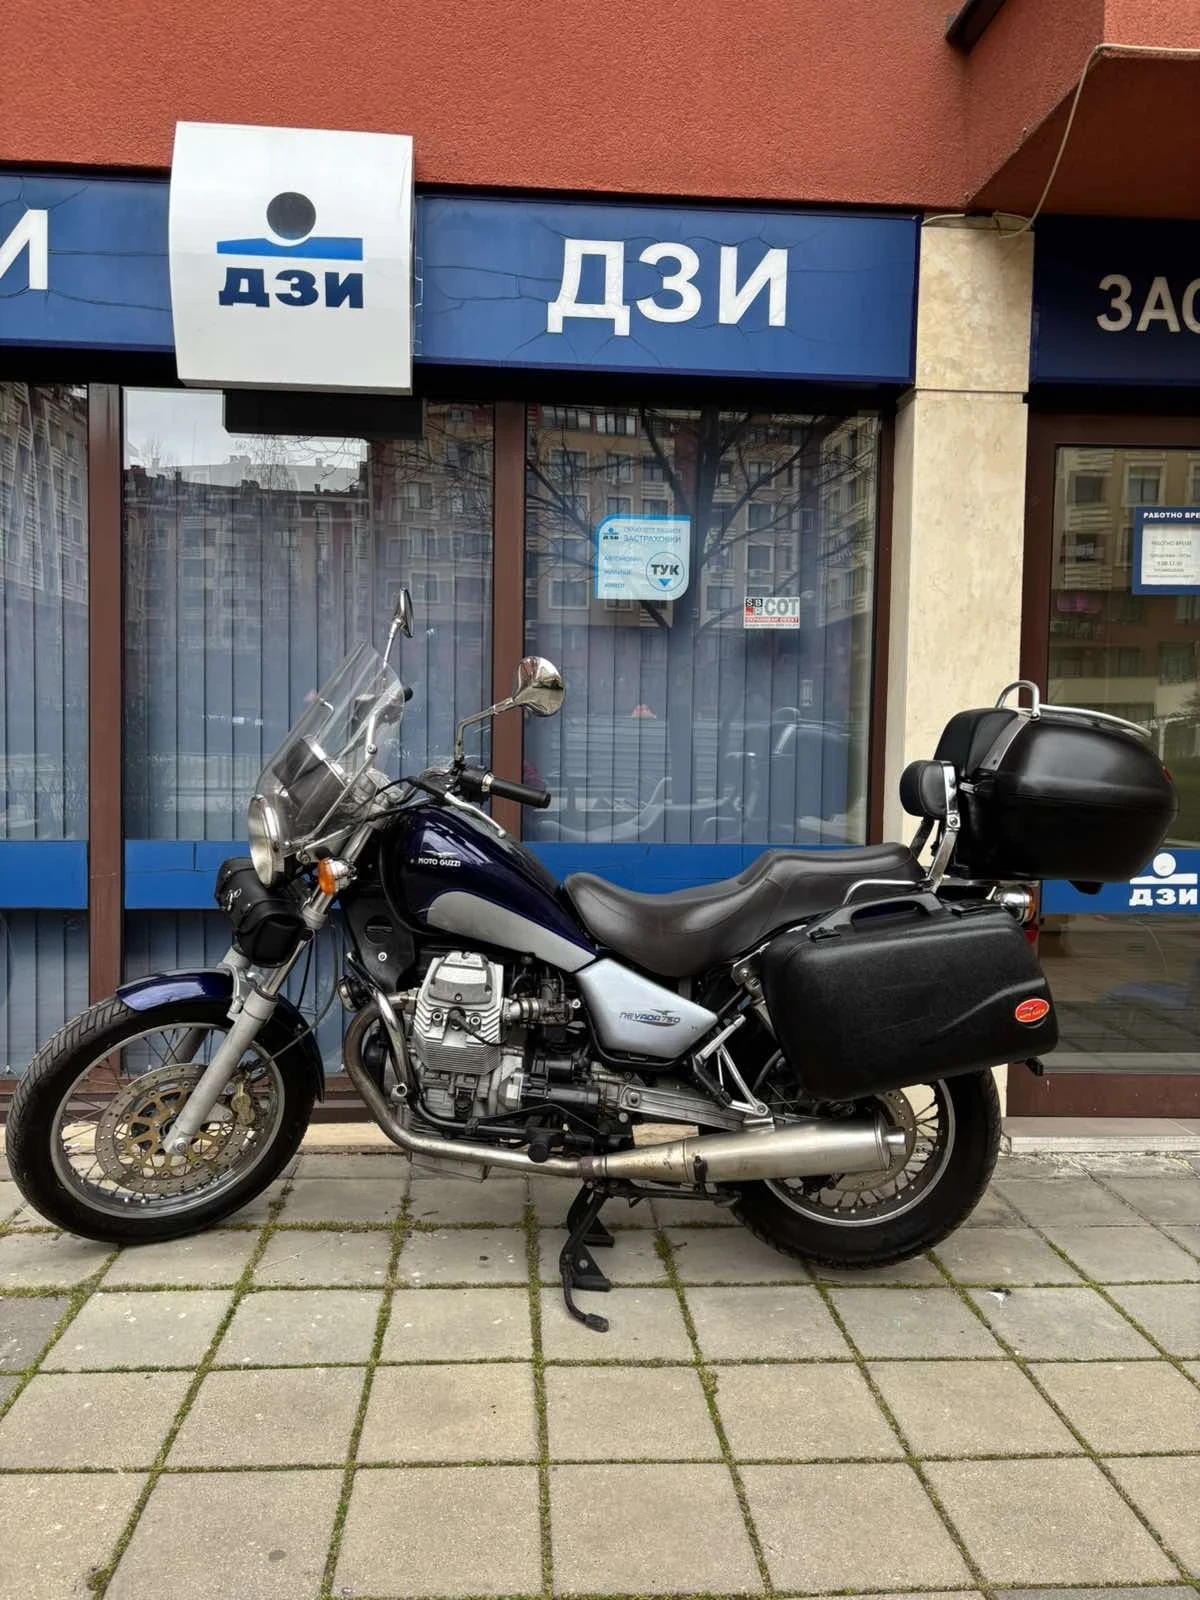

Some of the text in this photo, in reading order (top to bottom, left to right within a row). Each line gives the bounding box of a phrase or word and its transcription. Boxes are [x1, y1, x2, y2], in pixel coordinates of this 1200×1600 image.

[218, 267, 364, 308] ДЗИ
[547, 238, 788, 337] ДЗИ
[651, 564, 680, 576] ТУК
[419, 857, 461, 867] MOTO GUZZI
[1129, 888, 1198, 907] ДЗИ
